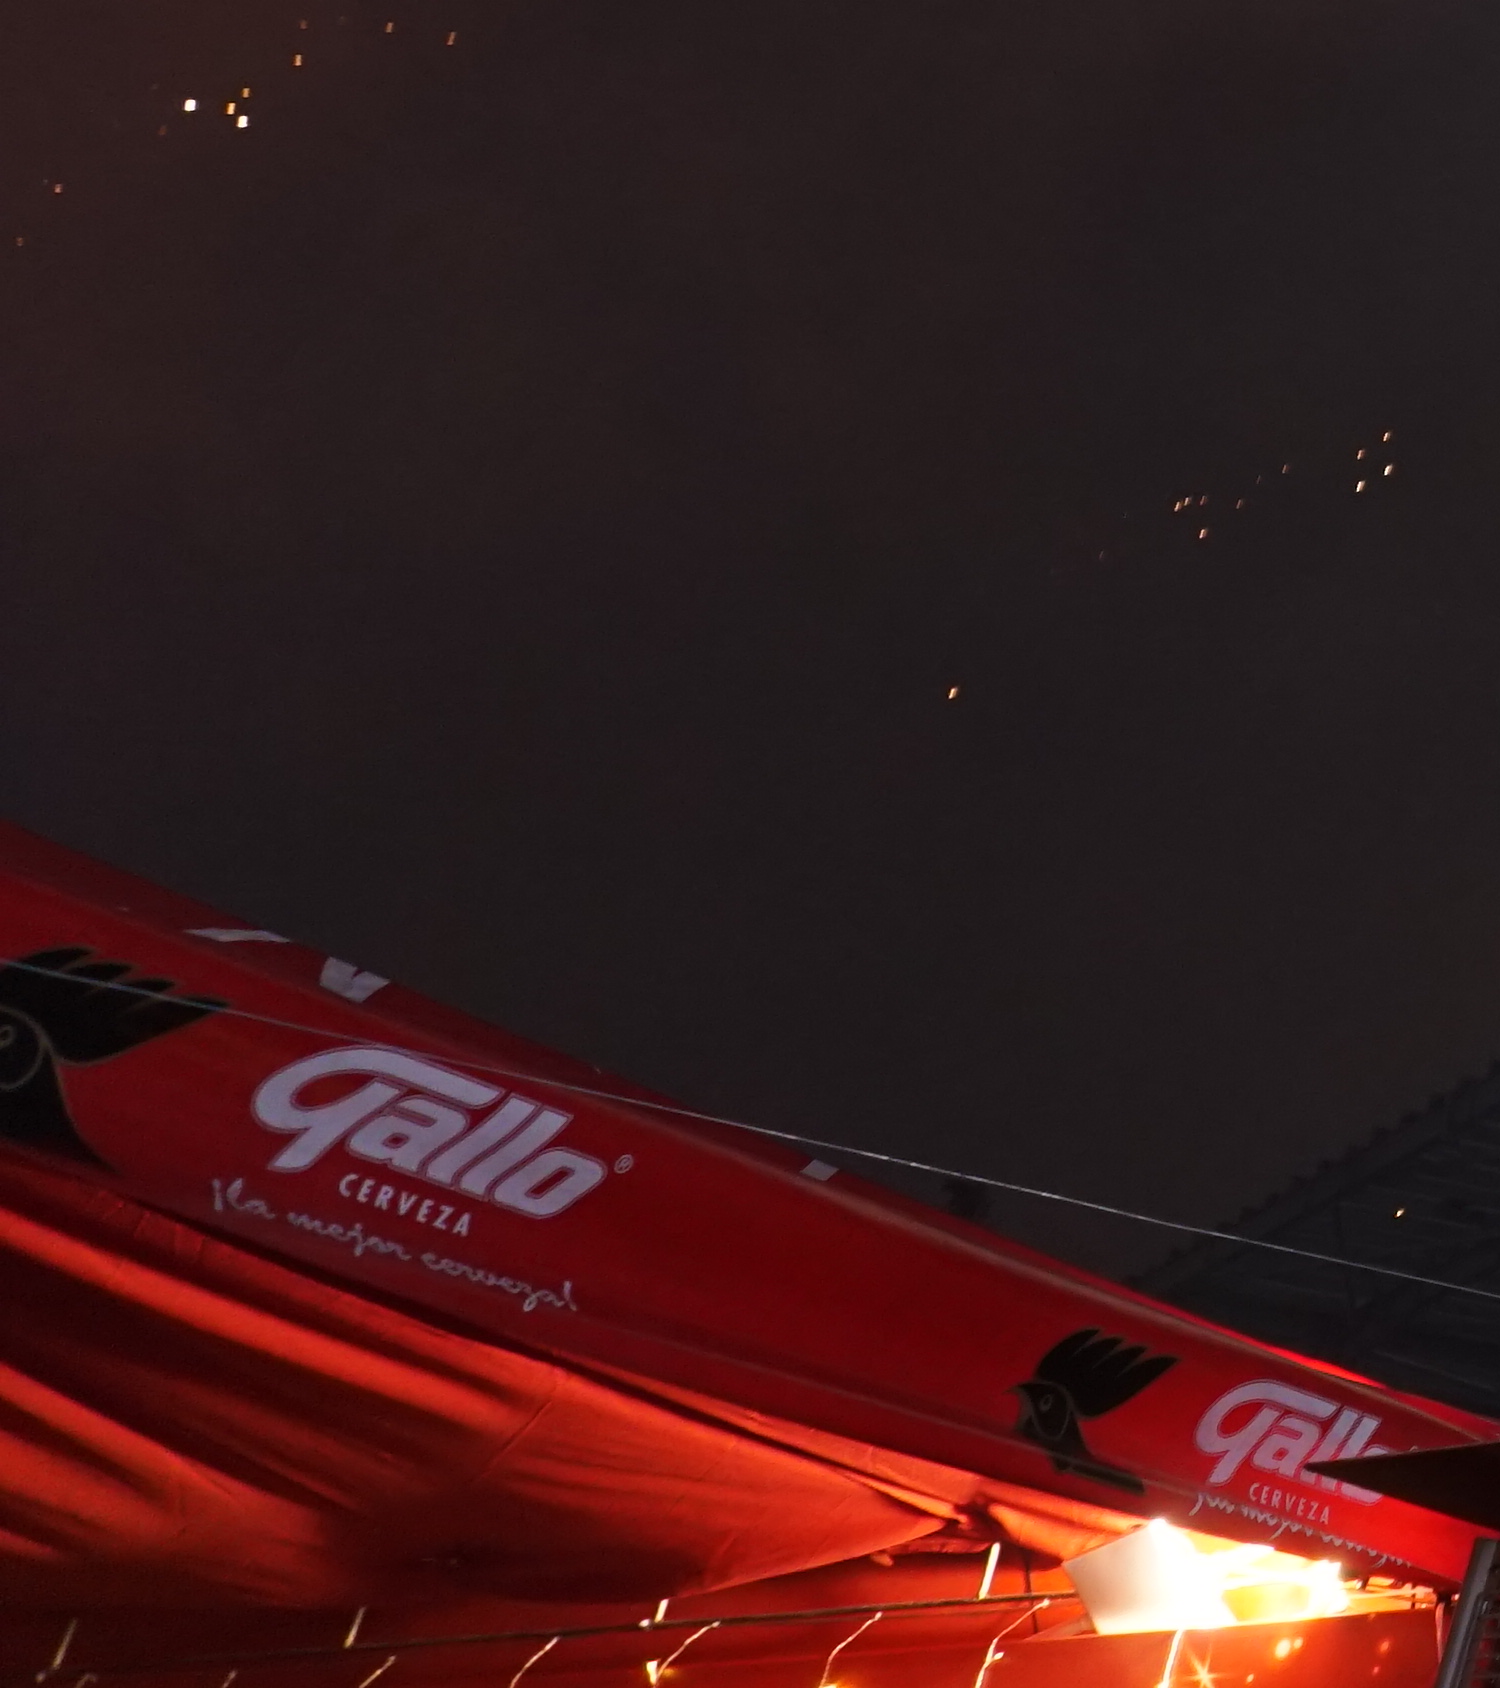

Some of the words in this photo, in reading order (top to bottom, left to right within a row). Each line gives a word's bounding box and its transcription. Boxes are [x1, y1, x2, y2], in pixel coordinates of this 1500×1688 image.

[250, 1044, 608, 1219] Gallo
[338, 1173, 473, 1237] CERVEZA
[286, 1211, 412, 1262] mejor
[1249, 1481, 1332, 1525] CERVEZA
